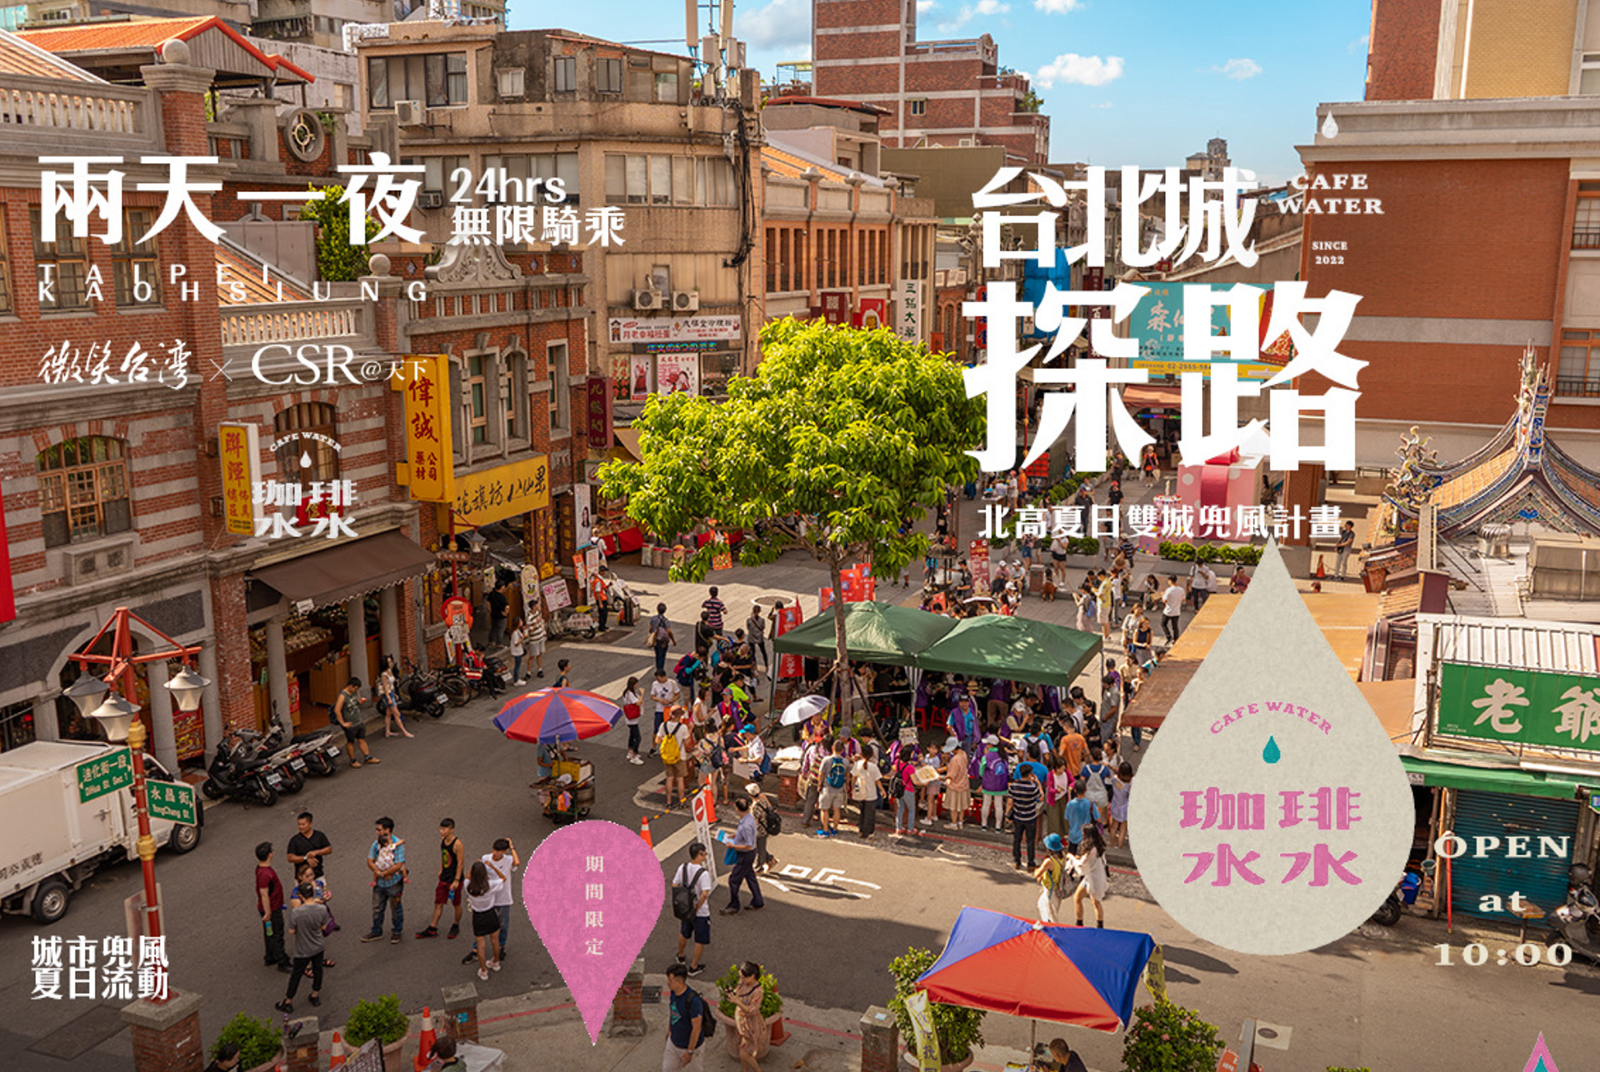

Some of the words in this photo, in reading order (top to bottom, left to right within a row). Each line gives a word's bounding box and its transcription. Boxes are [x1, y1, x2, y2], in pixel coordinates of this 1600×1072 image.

[82, 754, 127, 782] 迪化街一段
[150, 785, 190, 805] 永昌街
